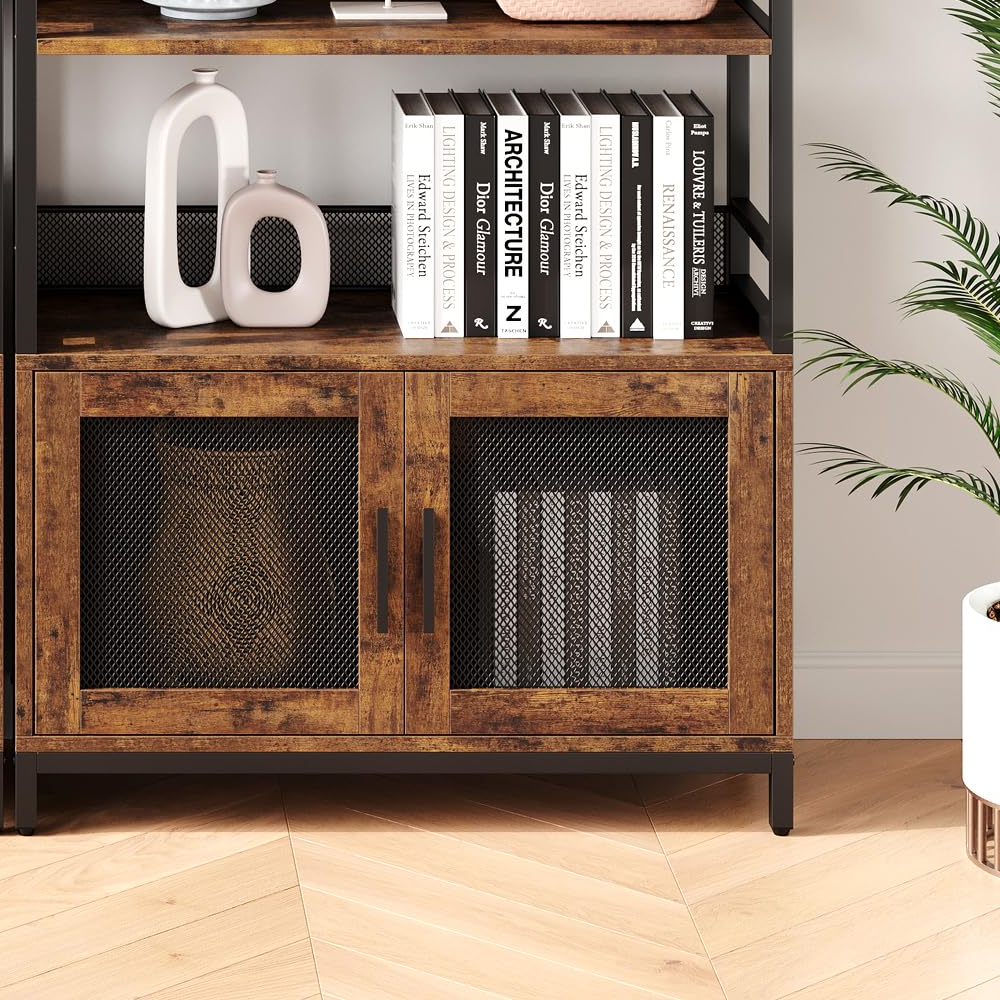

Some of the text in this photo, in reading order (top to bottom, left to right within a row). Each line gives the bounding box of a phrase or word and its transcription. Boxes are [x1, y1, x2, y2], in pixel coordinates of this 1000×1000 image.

[443, 127, 456, 186] LIGHTING
[479, 121, 488, 155] Mark Shaw
[543, 121, 551, 155] Mark Shaw
[600, 127, 612, 186] LIGHTING
[406, 174, 415, 198] LIVES
[564, 174, 572, 198] LIVES
[692, 149, 706, 200] LOUVRE
[406, 199, 415, 210] IN
[418, 175, 431, 277] Edward Steichen
[443, 191, 455, 236] DESIGN
[477, 182, 490, 275] Dior Glamour
[505, 129, 522, 277] ARCHITECTURE
[540, 182, 554, 275] Dior Glamour
[564, 199, 572, 210] IN
[575, 175, 587, 276] Edward Steichen
[600, 191, 612, 236] DESIGN
[692, 202, 702, 210] &
[663, 184, 675, 288] RENAISSANCE
[443, 254, 455, 309] PROCESS
[600, 255, 612, 309] PROCESS
